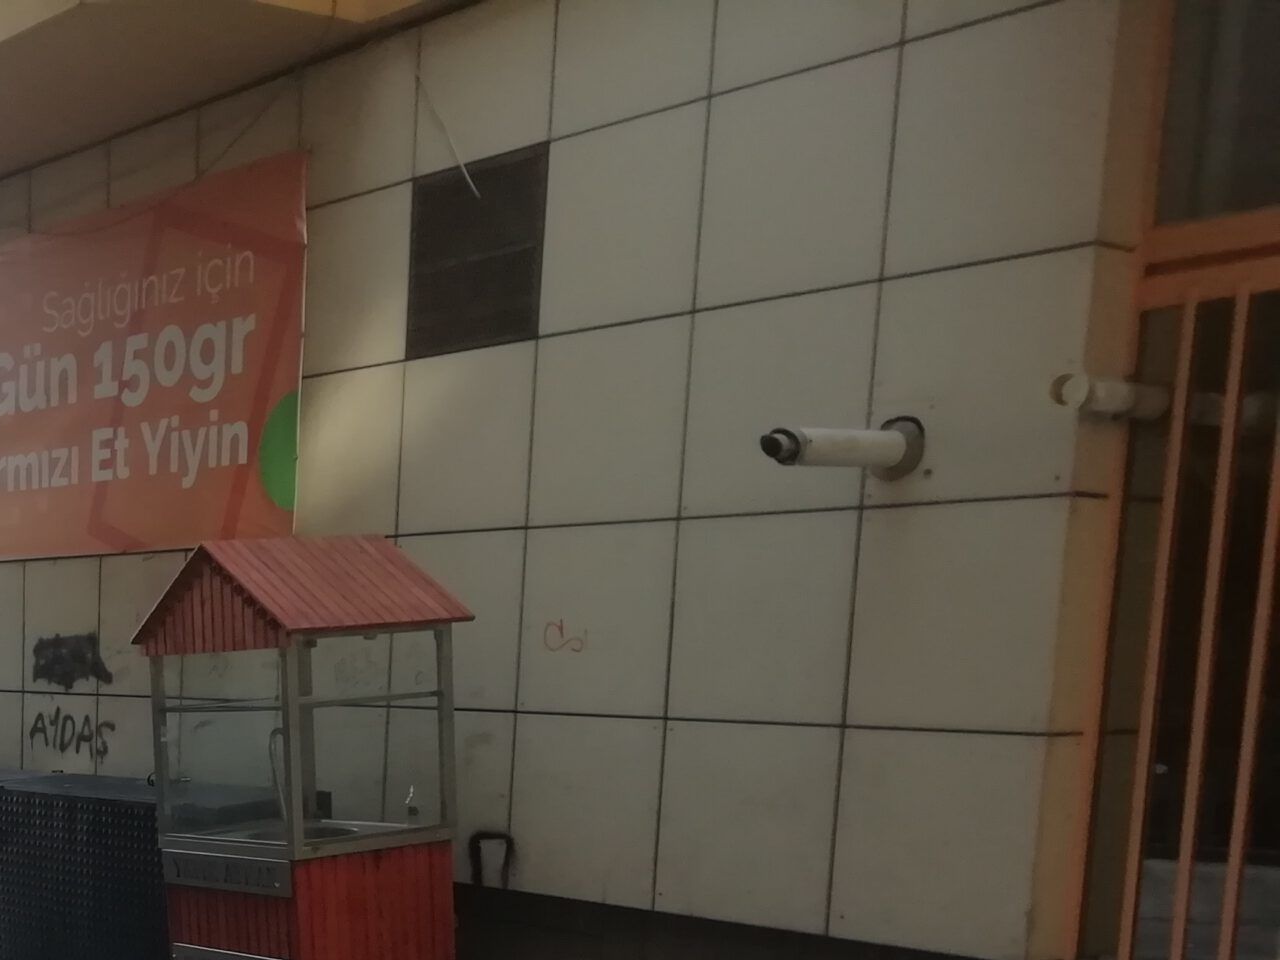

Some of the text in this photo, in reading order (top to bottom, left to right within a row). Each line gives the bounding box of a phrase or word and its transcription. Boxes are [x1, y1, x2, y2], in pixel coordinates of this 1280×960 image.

[196, 243, 255, 304] için
[93, 312, 256, 408] 150gr
[91, 426, 131, 483] Et
[140, 408, 249, 490] Yiyin
